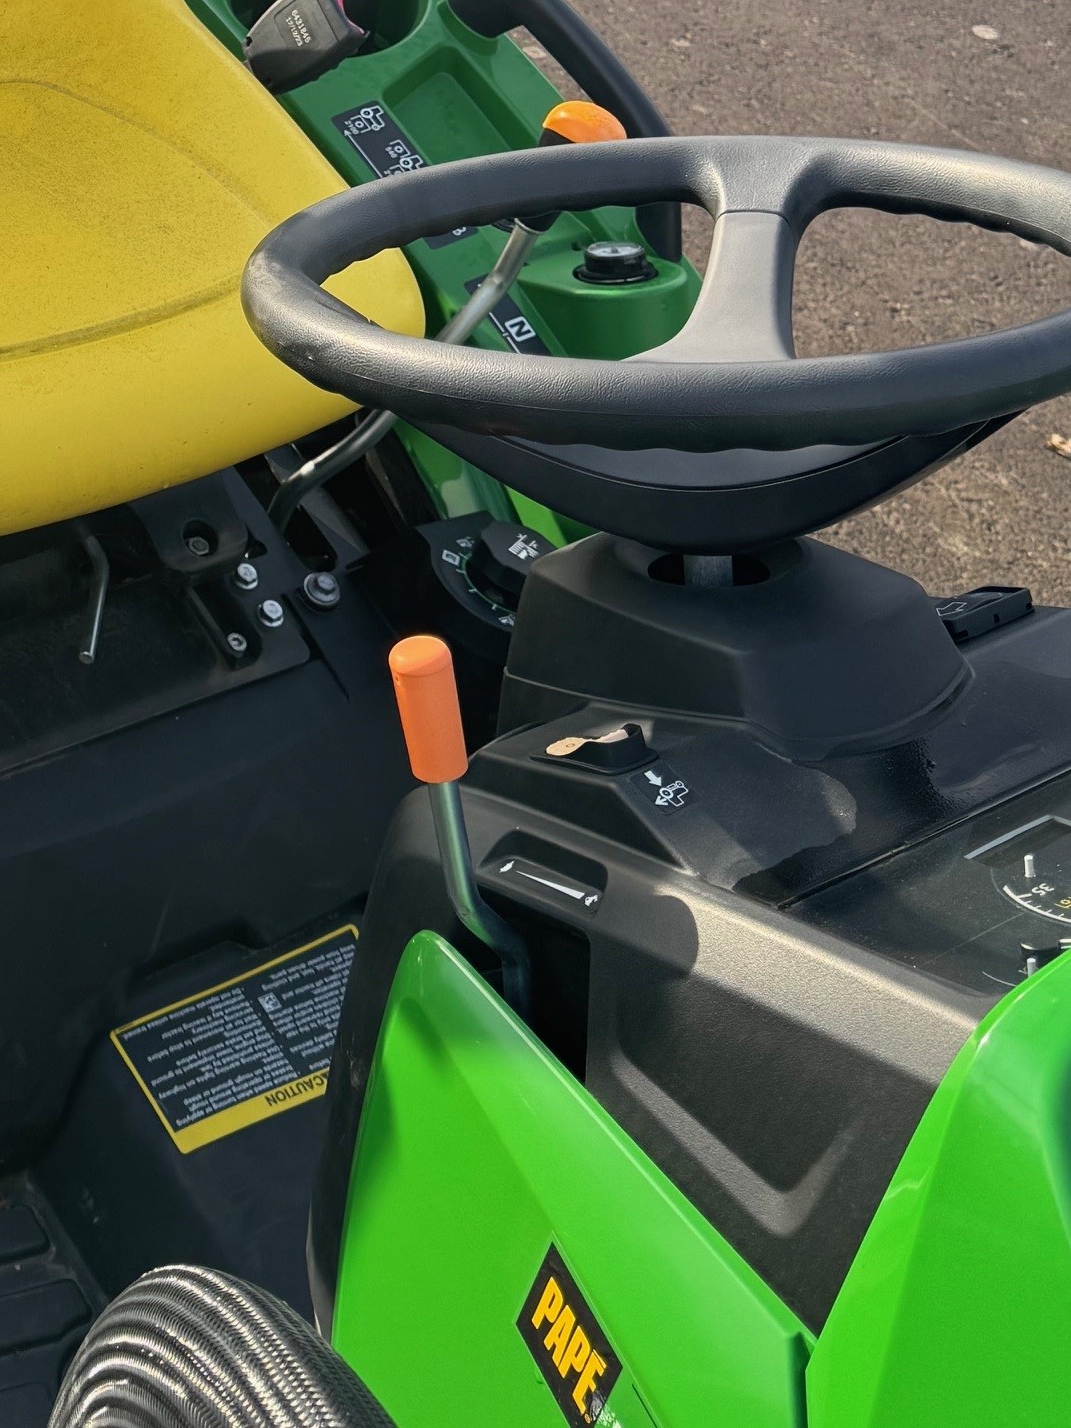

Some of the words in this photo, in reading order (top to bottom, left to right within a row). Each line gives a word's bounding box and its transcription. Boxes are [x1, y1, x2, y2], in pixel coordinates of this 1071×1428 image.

[509, 320, 531, 337] N
[1031, 882, 1055, 897] 35
[266, 1075, 325, 1107] CAUTION
